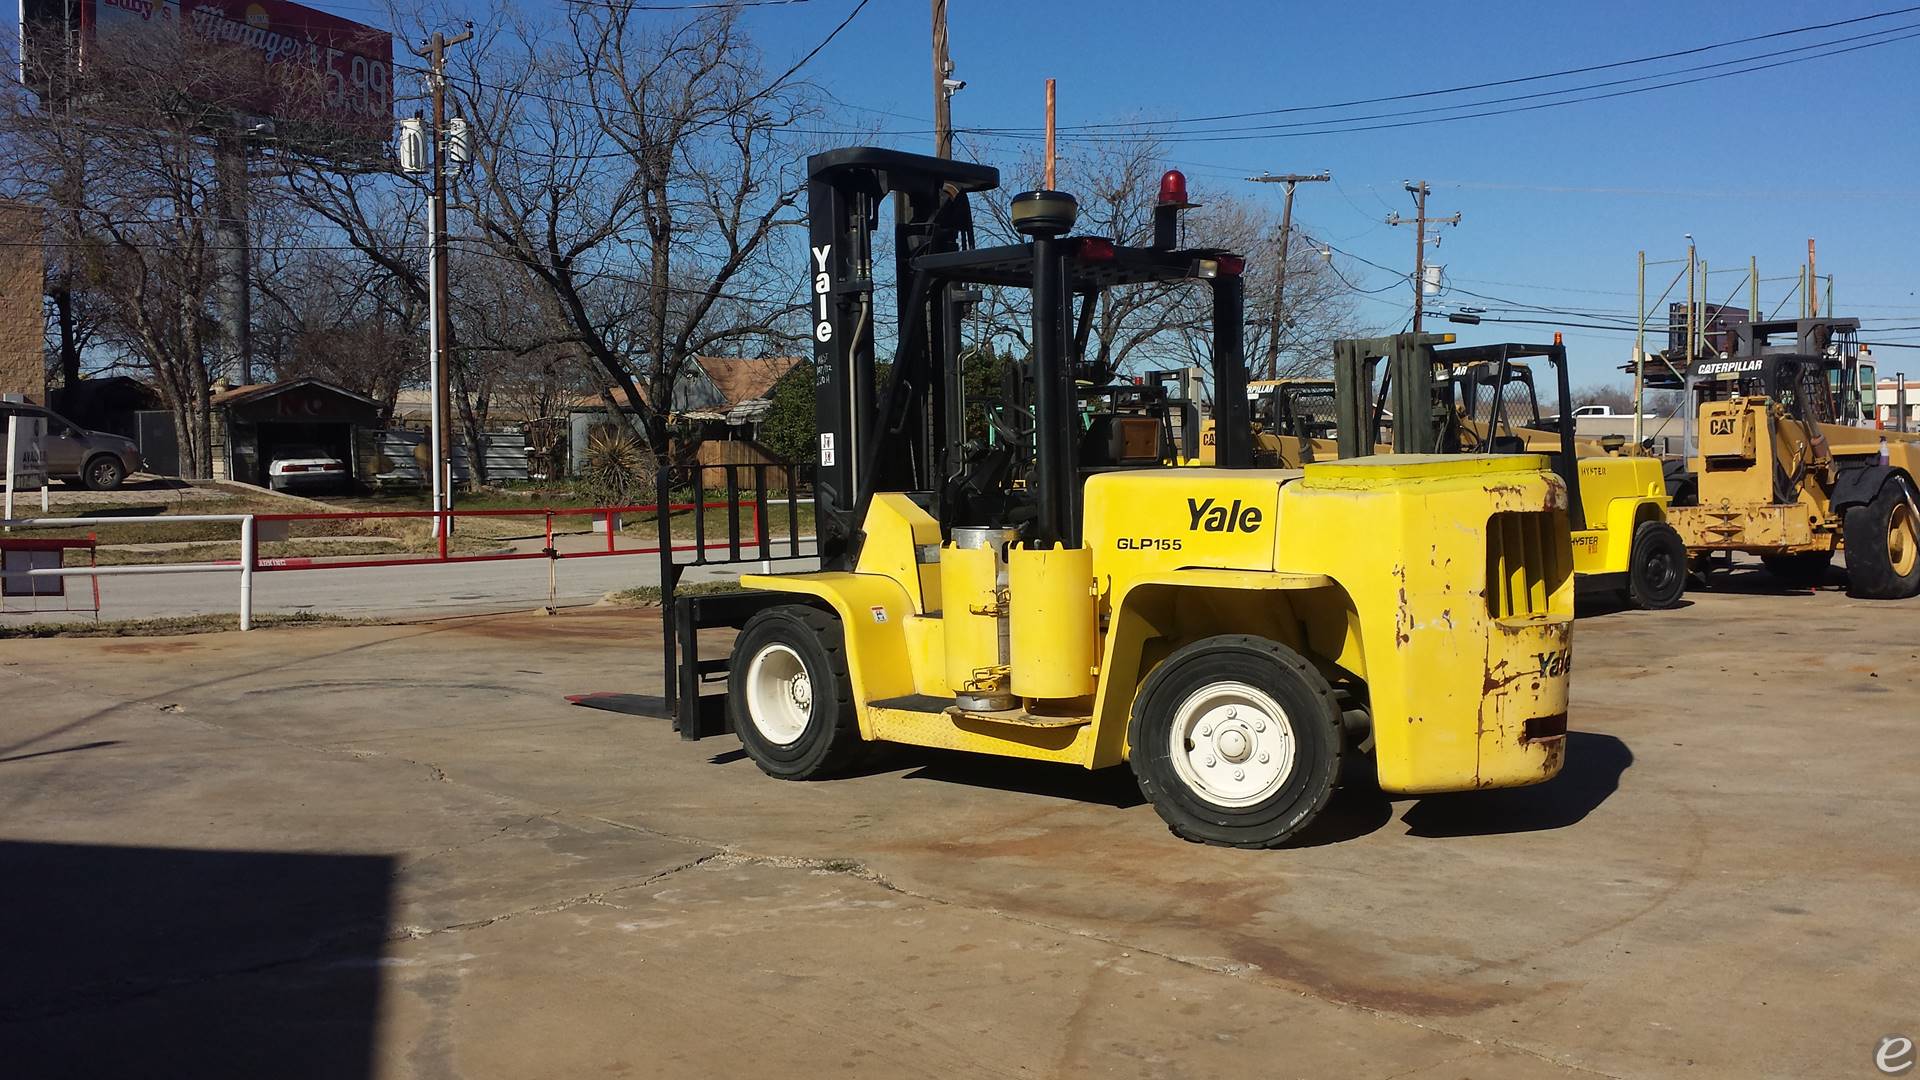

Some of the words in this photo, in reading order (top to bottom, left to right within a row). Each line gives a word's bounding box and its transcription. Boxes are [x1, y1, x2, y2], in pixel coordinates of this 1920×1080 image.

[812, 244, 833, 343] Yale
[1698, 360, 1763, 374] CATERPILLAR
[1247, 385, 1275, 394] RPILLAR
[1710, 419, 1736, 435] CAT
[1203, 433, 1216, 446] CA
[1581, 467, 1607, 476] HYSTER
[1187, 498, 1262, 533] Yale
[1117, 538, 1182, 551] GLP155
